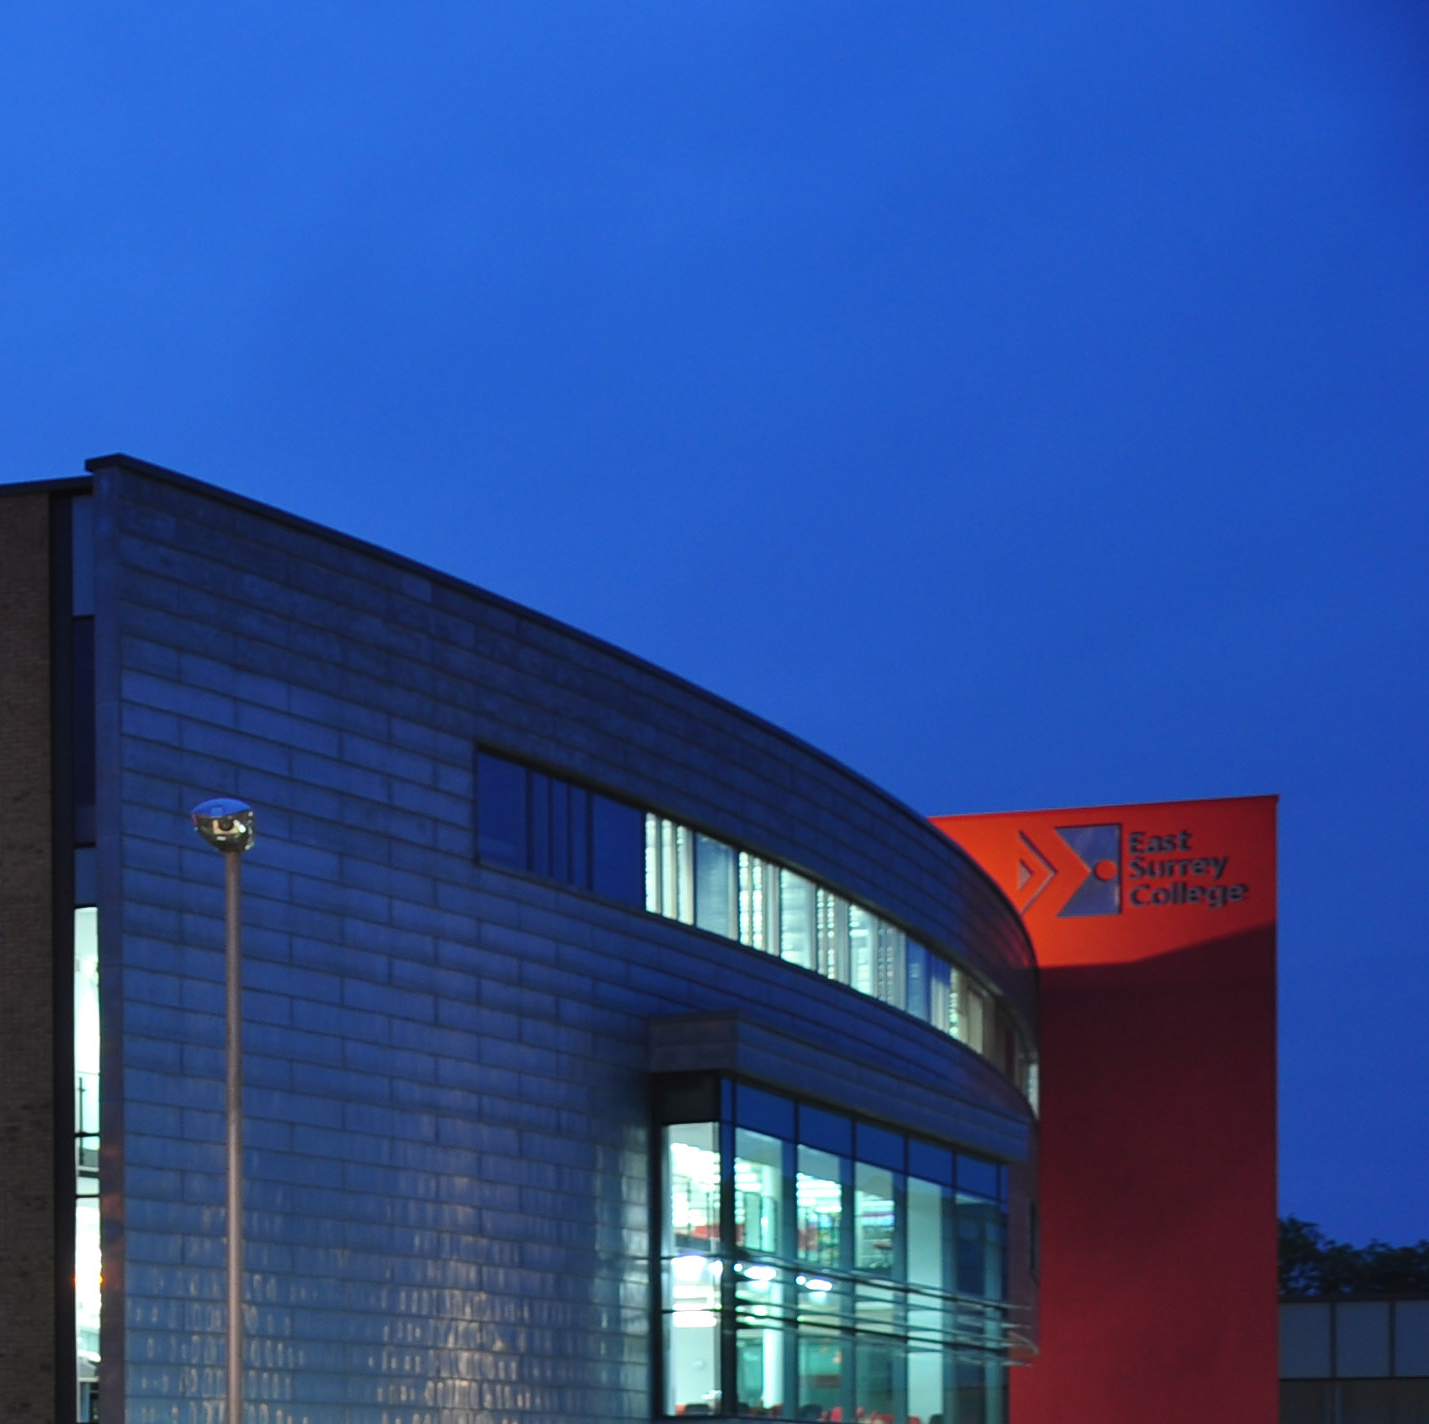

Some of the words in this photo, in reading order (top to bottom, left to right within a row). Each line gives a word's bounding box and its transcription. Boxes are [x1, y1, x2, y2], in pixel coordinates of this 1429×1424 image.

[1127, 830, 1193, 854] East
[1128, 855, 1229, 880] Surrey
[1129, 881, 1249, 908] College
